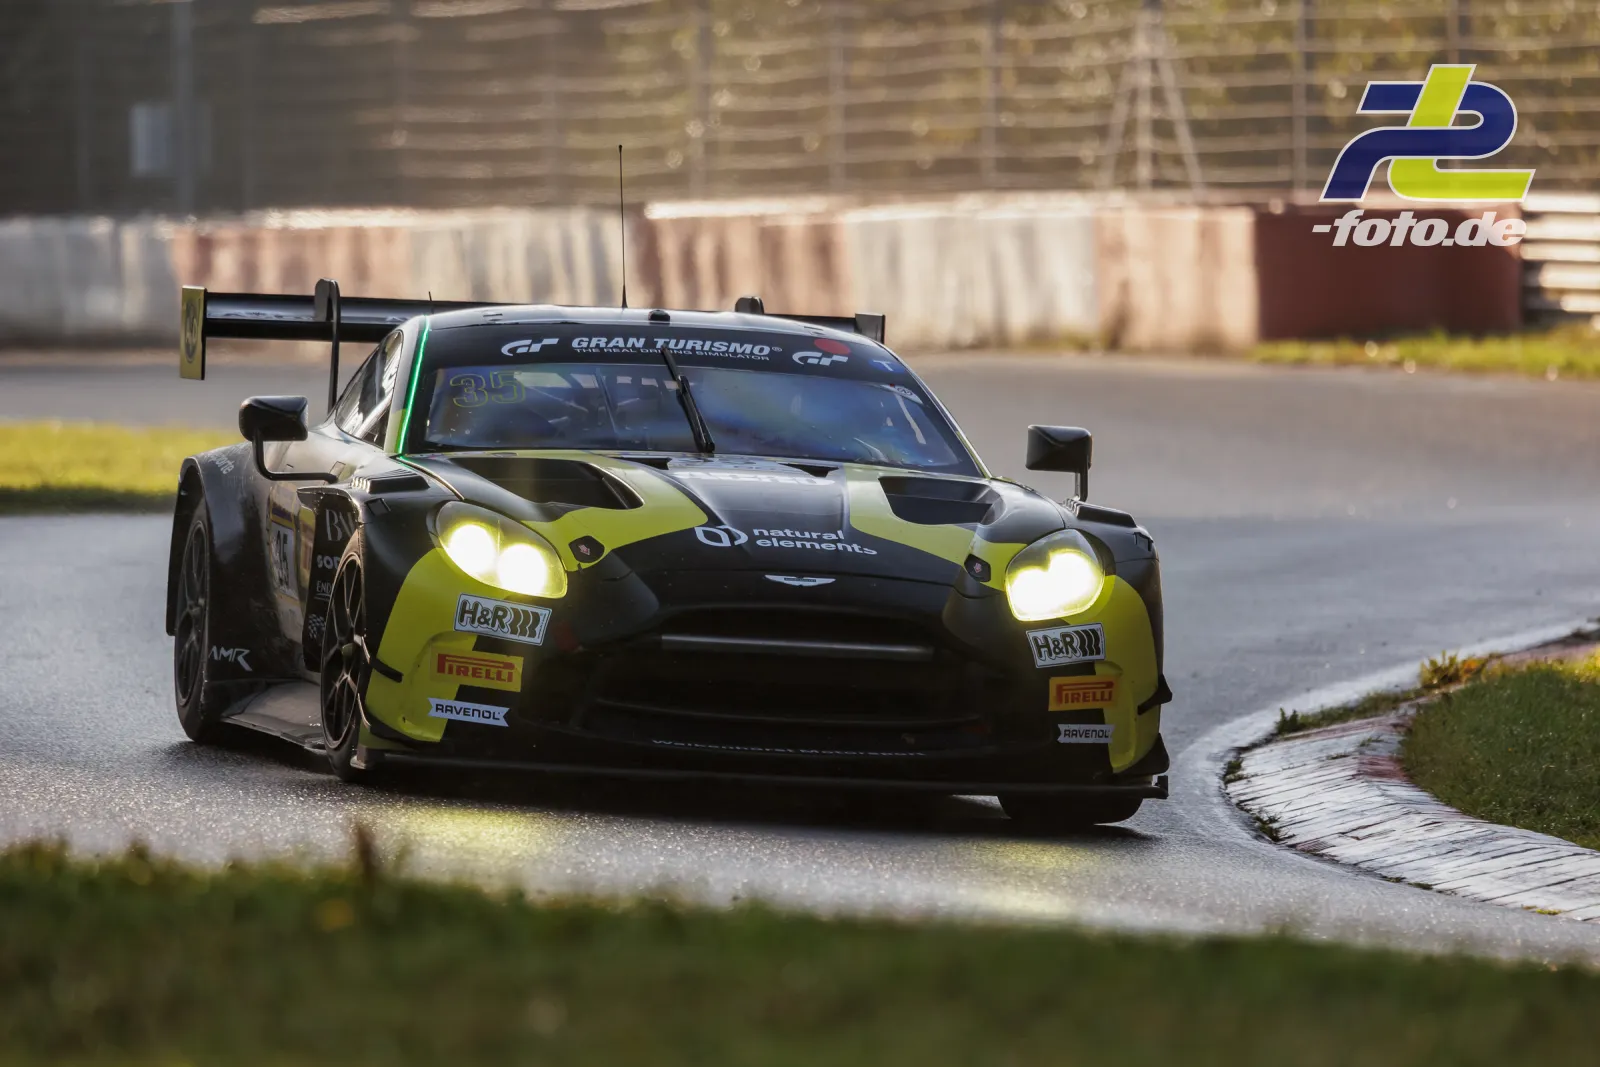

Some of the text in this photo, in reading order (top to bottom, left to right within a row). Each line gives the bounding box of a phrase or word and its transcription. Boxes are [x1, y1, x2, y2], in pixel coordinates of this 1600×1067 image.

[571, 337, 646, 348] GRAN
[696, 350, 770, 361] SIMULATOR
[450, 371, 526, 408] 35
[753, 528, 844, 540] natural
[756, 538, 878, 555] elements
[458, 600, 509, 632] H&R
[1032, 632, 1081, 661] H&R
[208, 645, 253, 672] AMR
[437, 653, 516, 683] PIRELLI
[1056, 681, 1114, 705] PIRELLI
[435, 704, 500, 721] RAVENOL
[1063, 729, 1109, 739] RAVENOL
